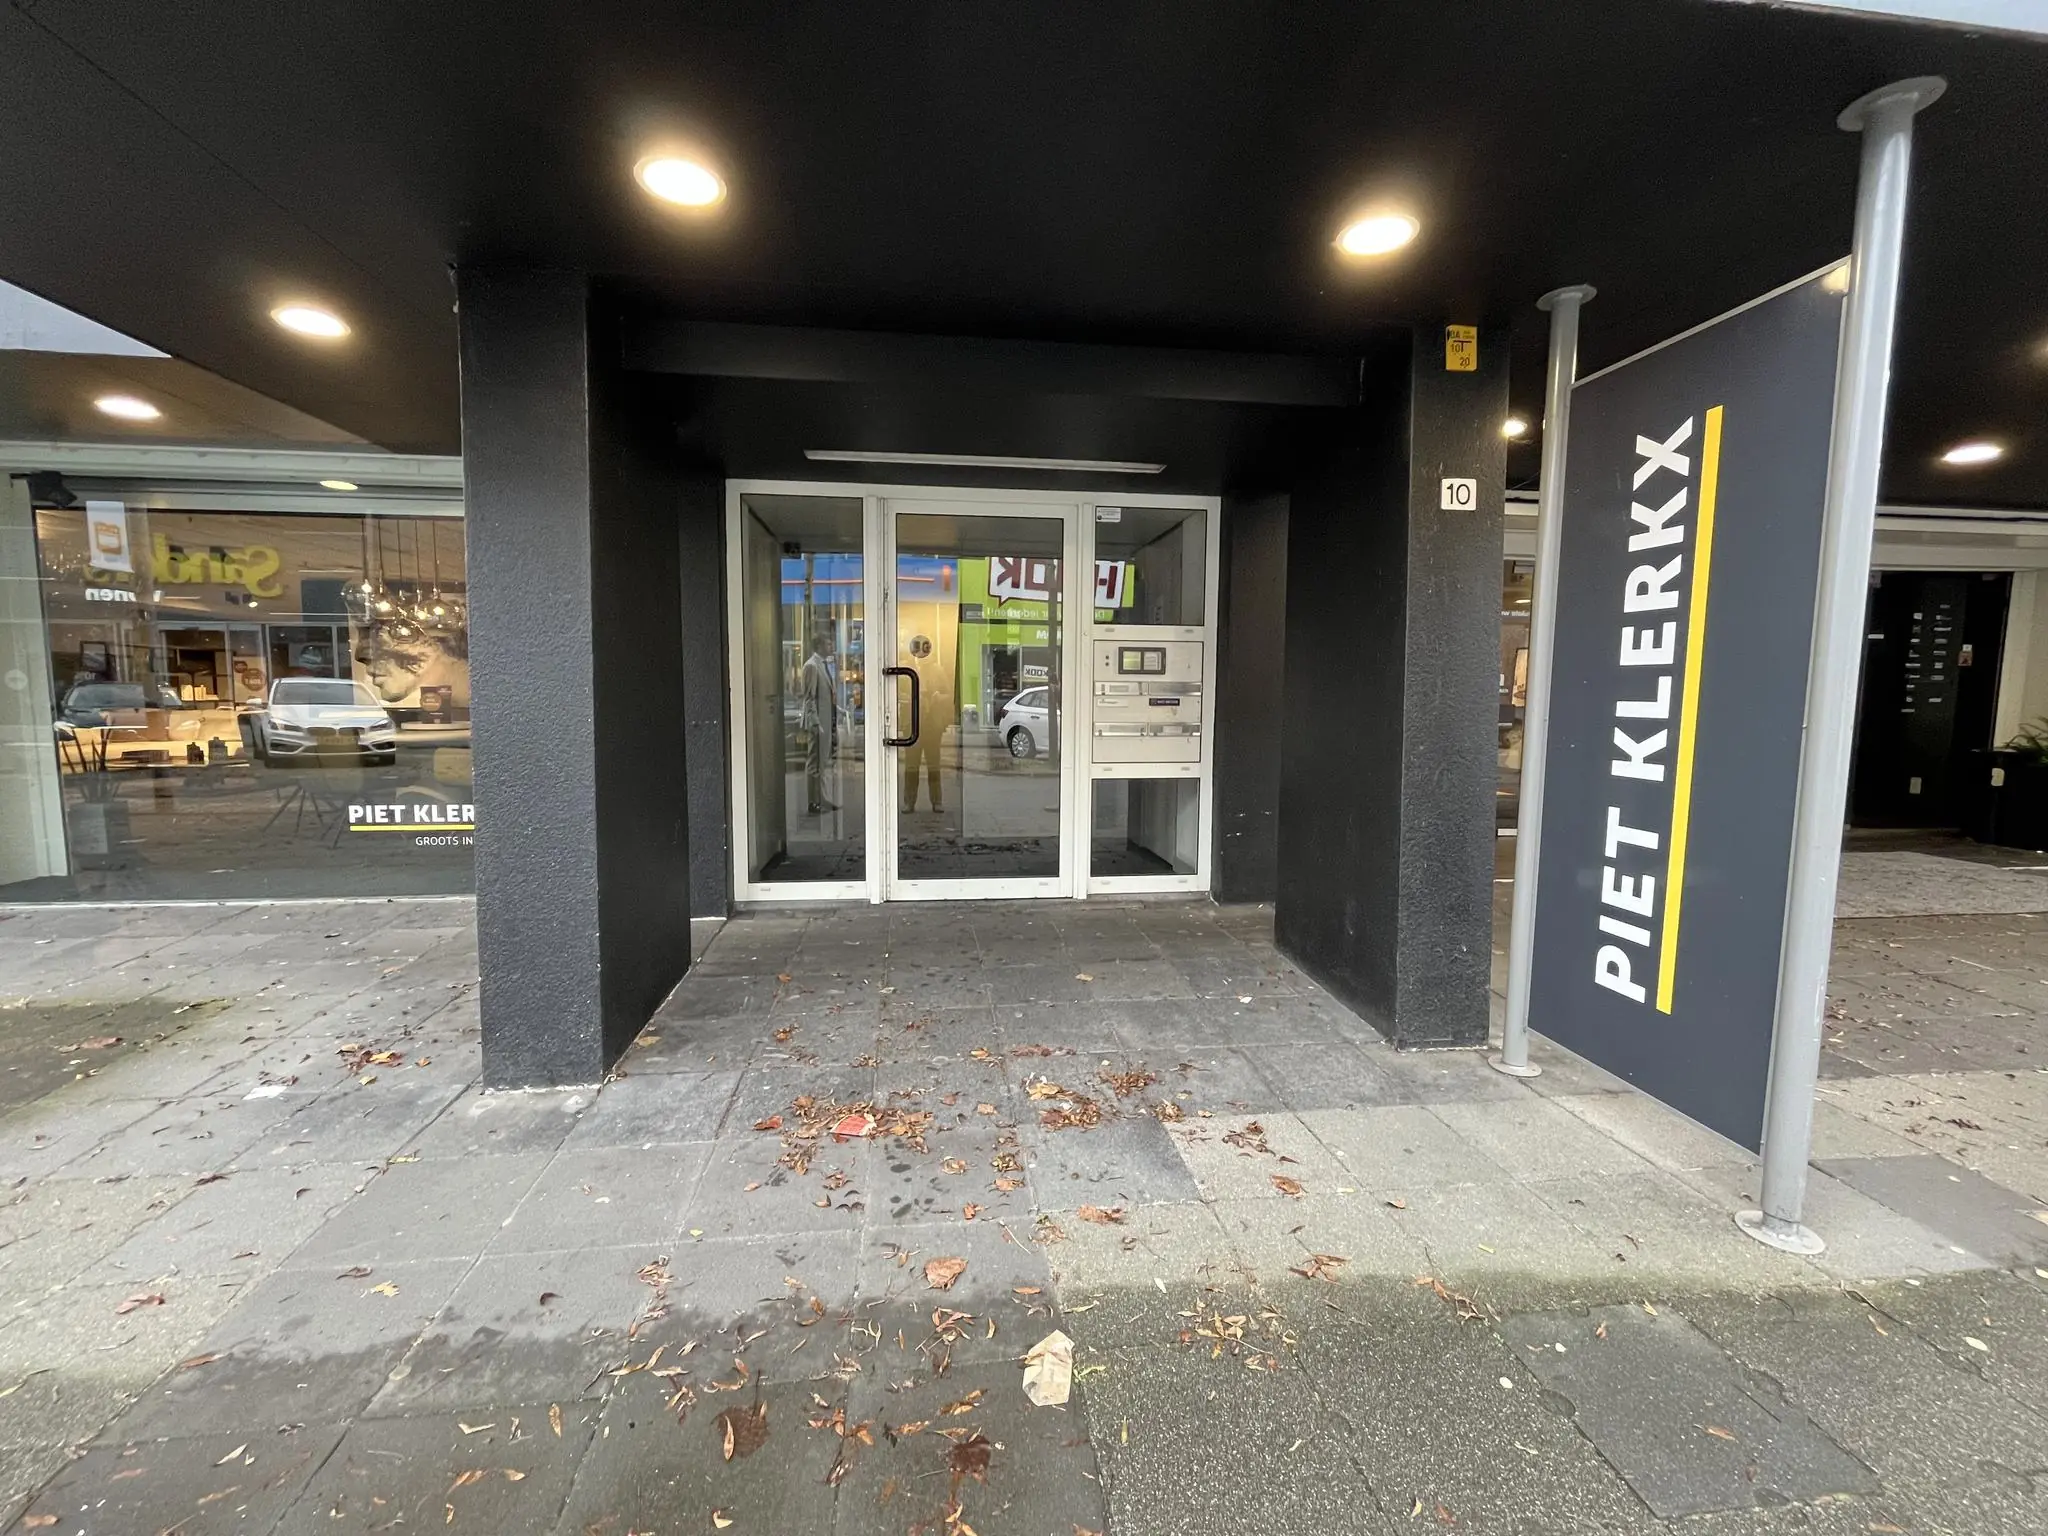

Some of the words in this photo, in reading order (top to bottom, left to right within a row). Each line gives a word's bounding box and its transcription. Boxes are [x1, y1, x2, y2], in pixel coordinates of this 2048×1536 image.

[1446, 483, 1471, 505] 10
[1611, 416, 1693, 782] KLERKX
[348, 804, 406, 823] PIET
[413, 804, 475, 823] KLER
[415, 836, 460, 846] GROOTS
[462, 836, 474, 846] IN
[1595, 806, 1659, 1004] PIET
